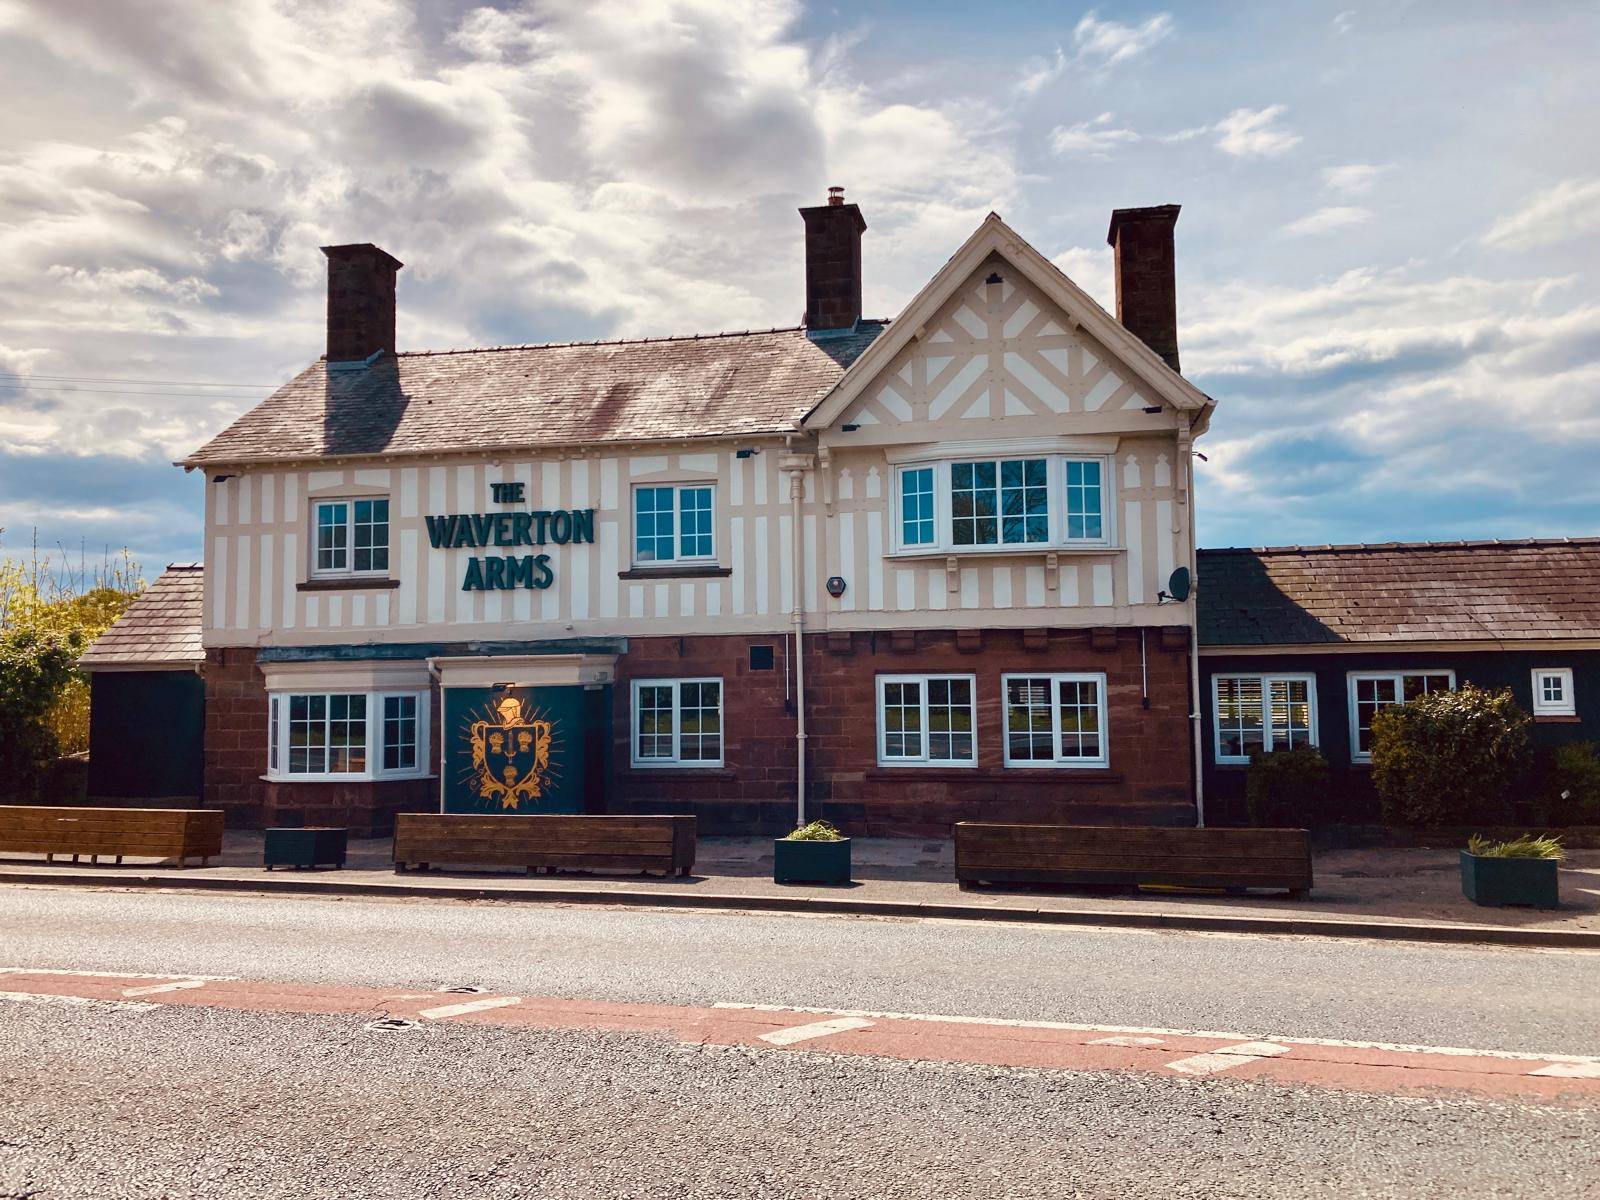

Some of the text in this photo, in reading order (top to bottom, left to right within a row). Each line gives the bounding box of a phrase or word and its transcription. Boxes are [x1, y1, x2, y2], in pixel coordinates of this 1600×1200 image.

[490, 482, 525, 503] THE
[424, 509, 595, 549] WAVERTON
[462, 554, 554, 591] ARMS
